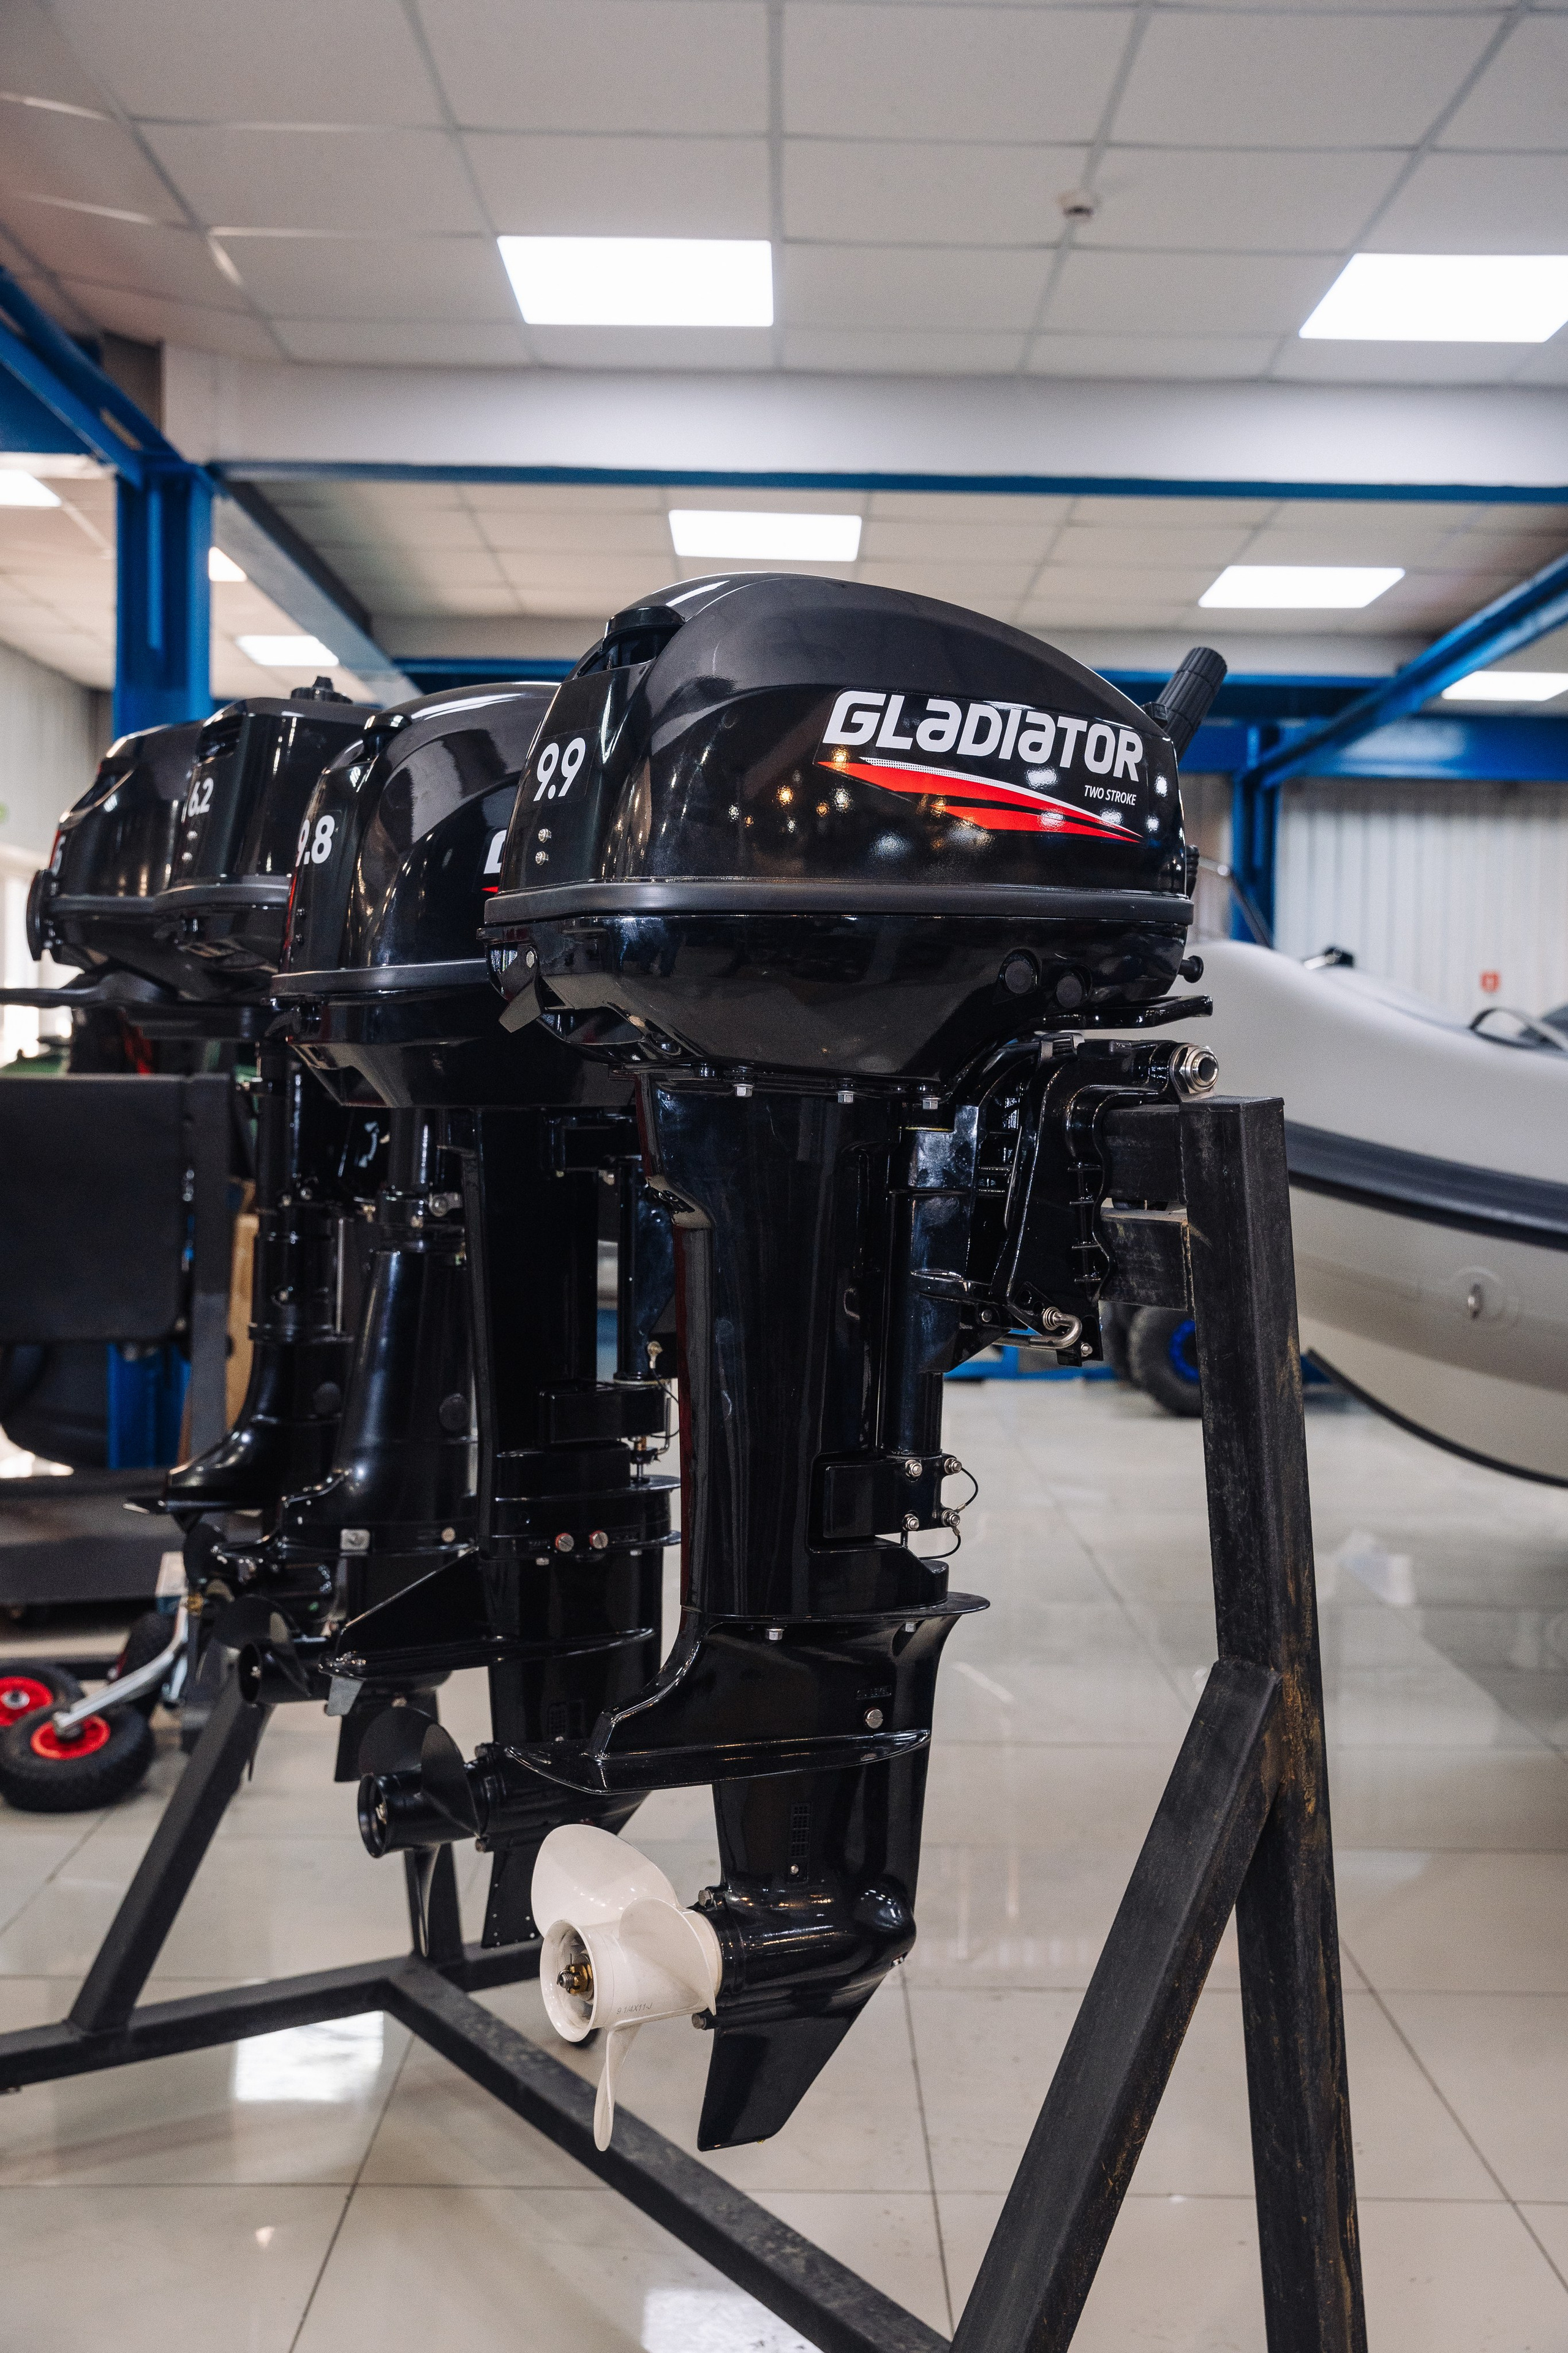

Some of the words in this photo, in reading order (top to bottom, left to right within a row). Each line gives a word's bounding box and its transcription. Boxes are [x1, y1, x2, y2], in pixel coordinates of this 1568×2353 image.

[533, 738, 586, 802] 9.9
[187, 777, 214, 817] 6.2
[1084, 785, 1104, 799] TWO
[1105, 789, 1137, 806] STROKE
[295, 815, 335, 867] 9.8
